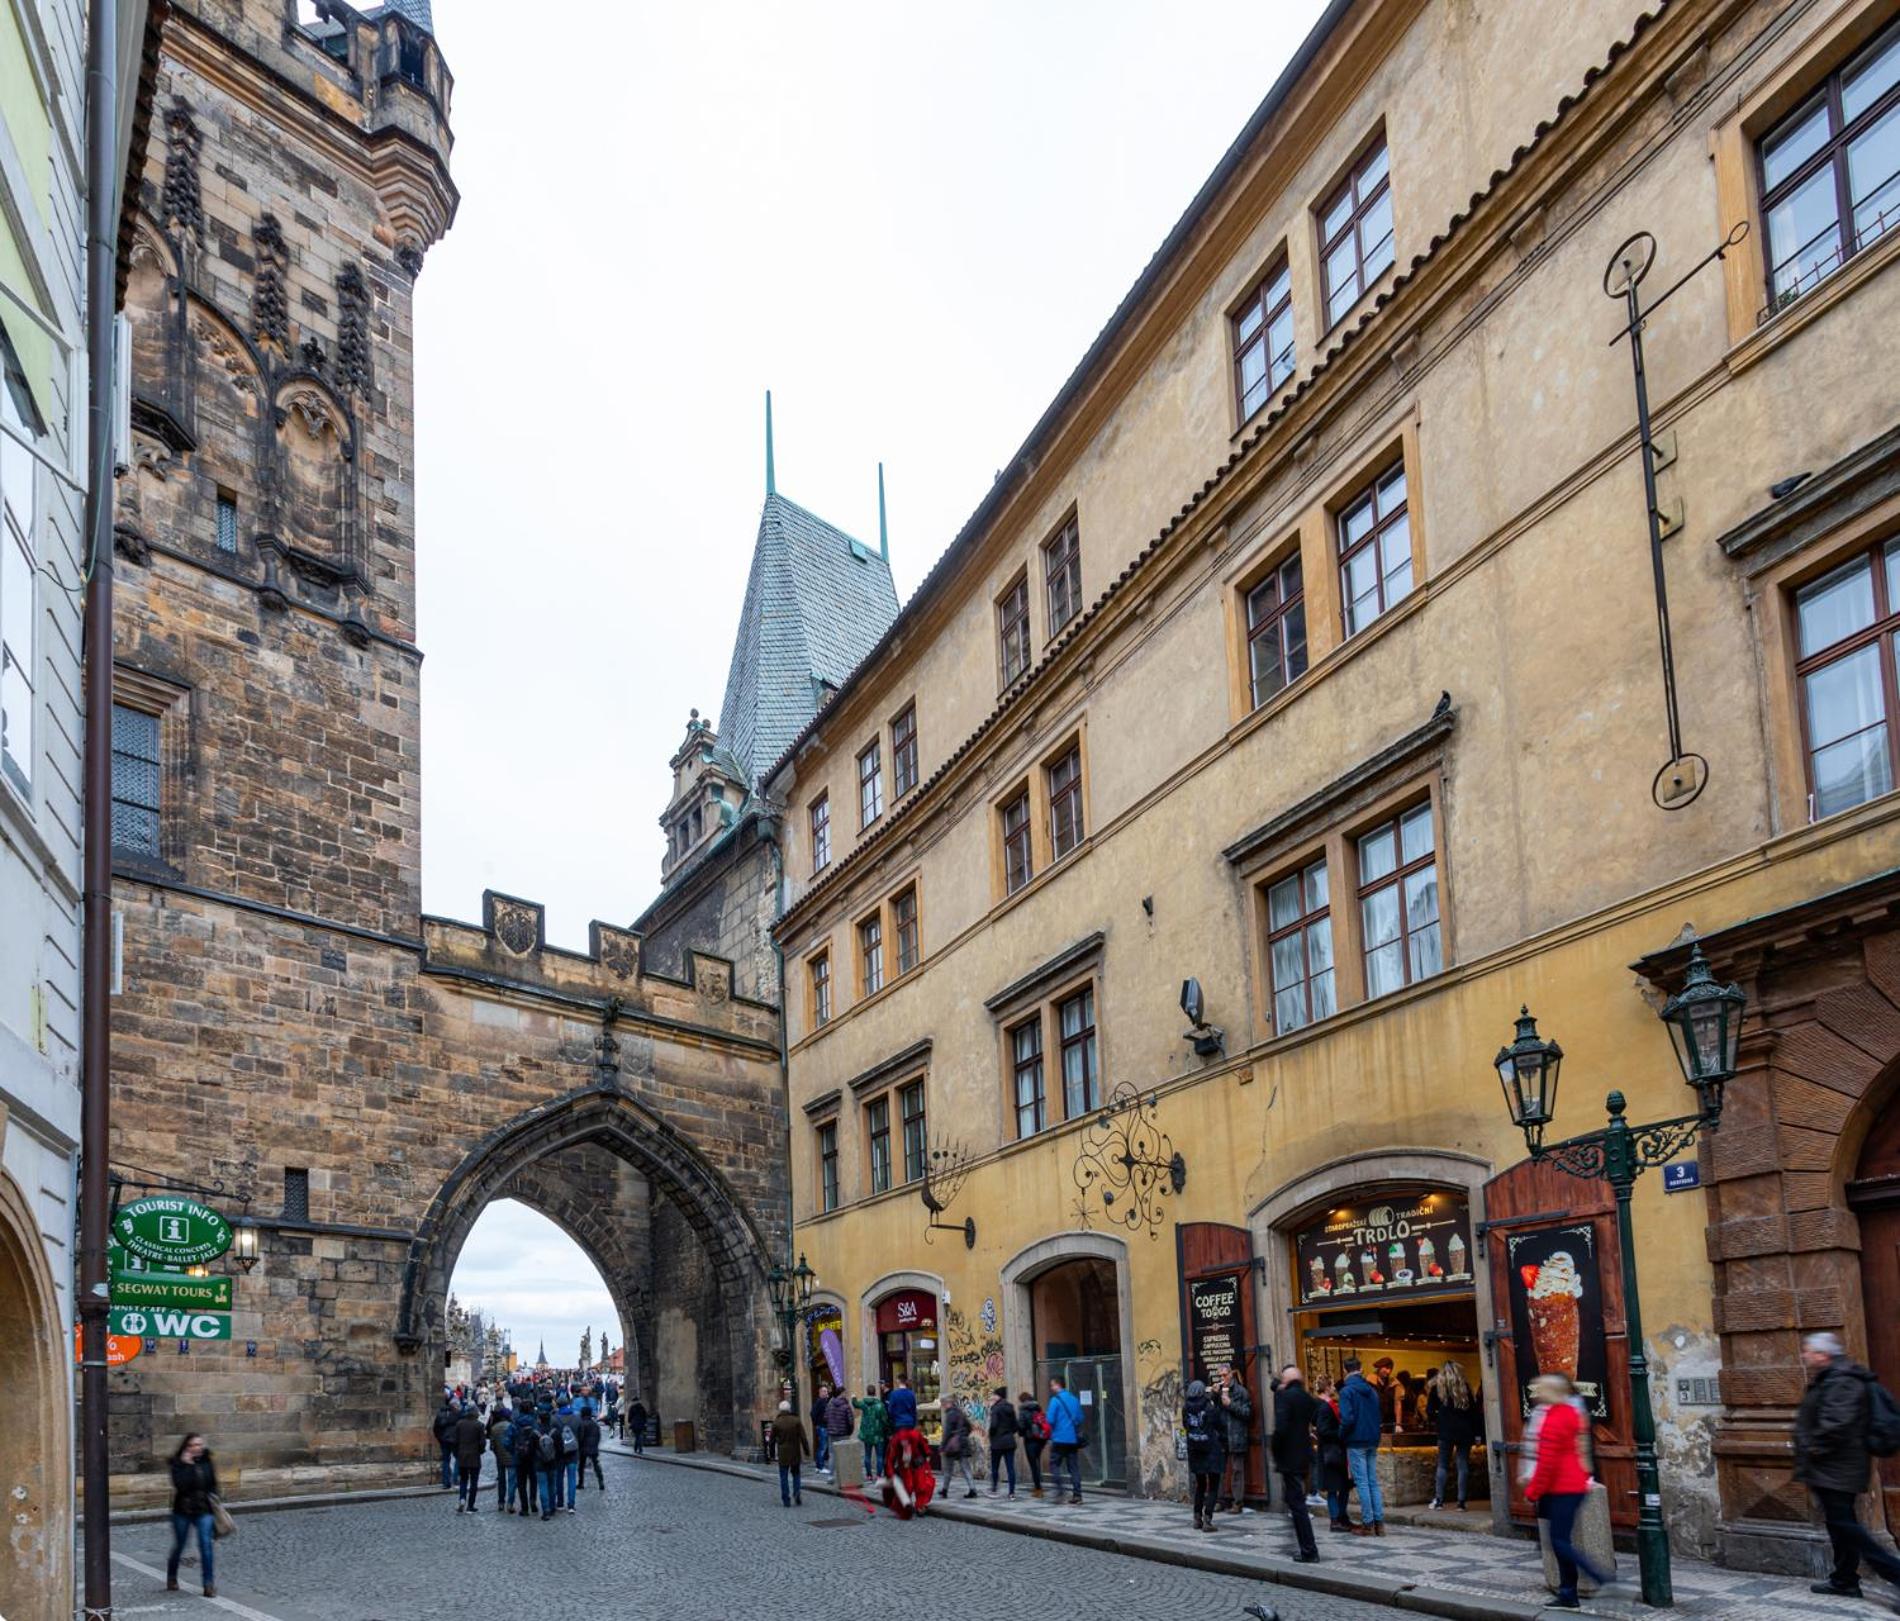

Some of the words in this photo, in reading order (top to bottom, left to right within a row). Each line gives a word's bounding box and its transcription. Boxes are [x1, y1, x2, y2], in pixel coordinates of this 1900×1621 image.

[1676, 1165, 1686, 1178] 3
[126, 1200, 185, 1217] TOURIST
[188, 1204, 219, 1226] INFO
[1354, 1220, 1410, 1245] TRDLO
[127, 1239, 163, 1260] THEATRE
[166, 1253, 197, 1263] BALLET
[199, 1247, 220, 1263] JAZZ
[135, 1235, 173, 1253] CLASSICAL
[174, 1242, 212, 1254] CONCERTS
[117, 1282, 169, 1295] SEGWAY
[172, 1286, 213, 1298] TOURS
[1195, 1292, 1234, 1308] COFFEE
[1200, 1308, 1212, 1318] TO
[1219, 1306, 1231, 1317] GO
[153, 1313, 221, 1338] WC
